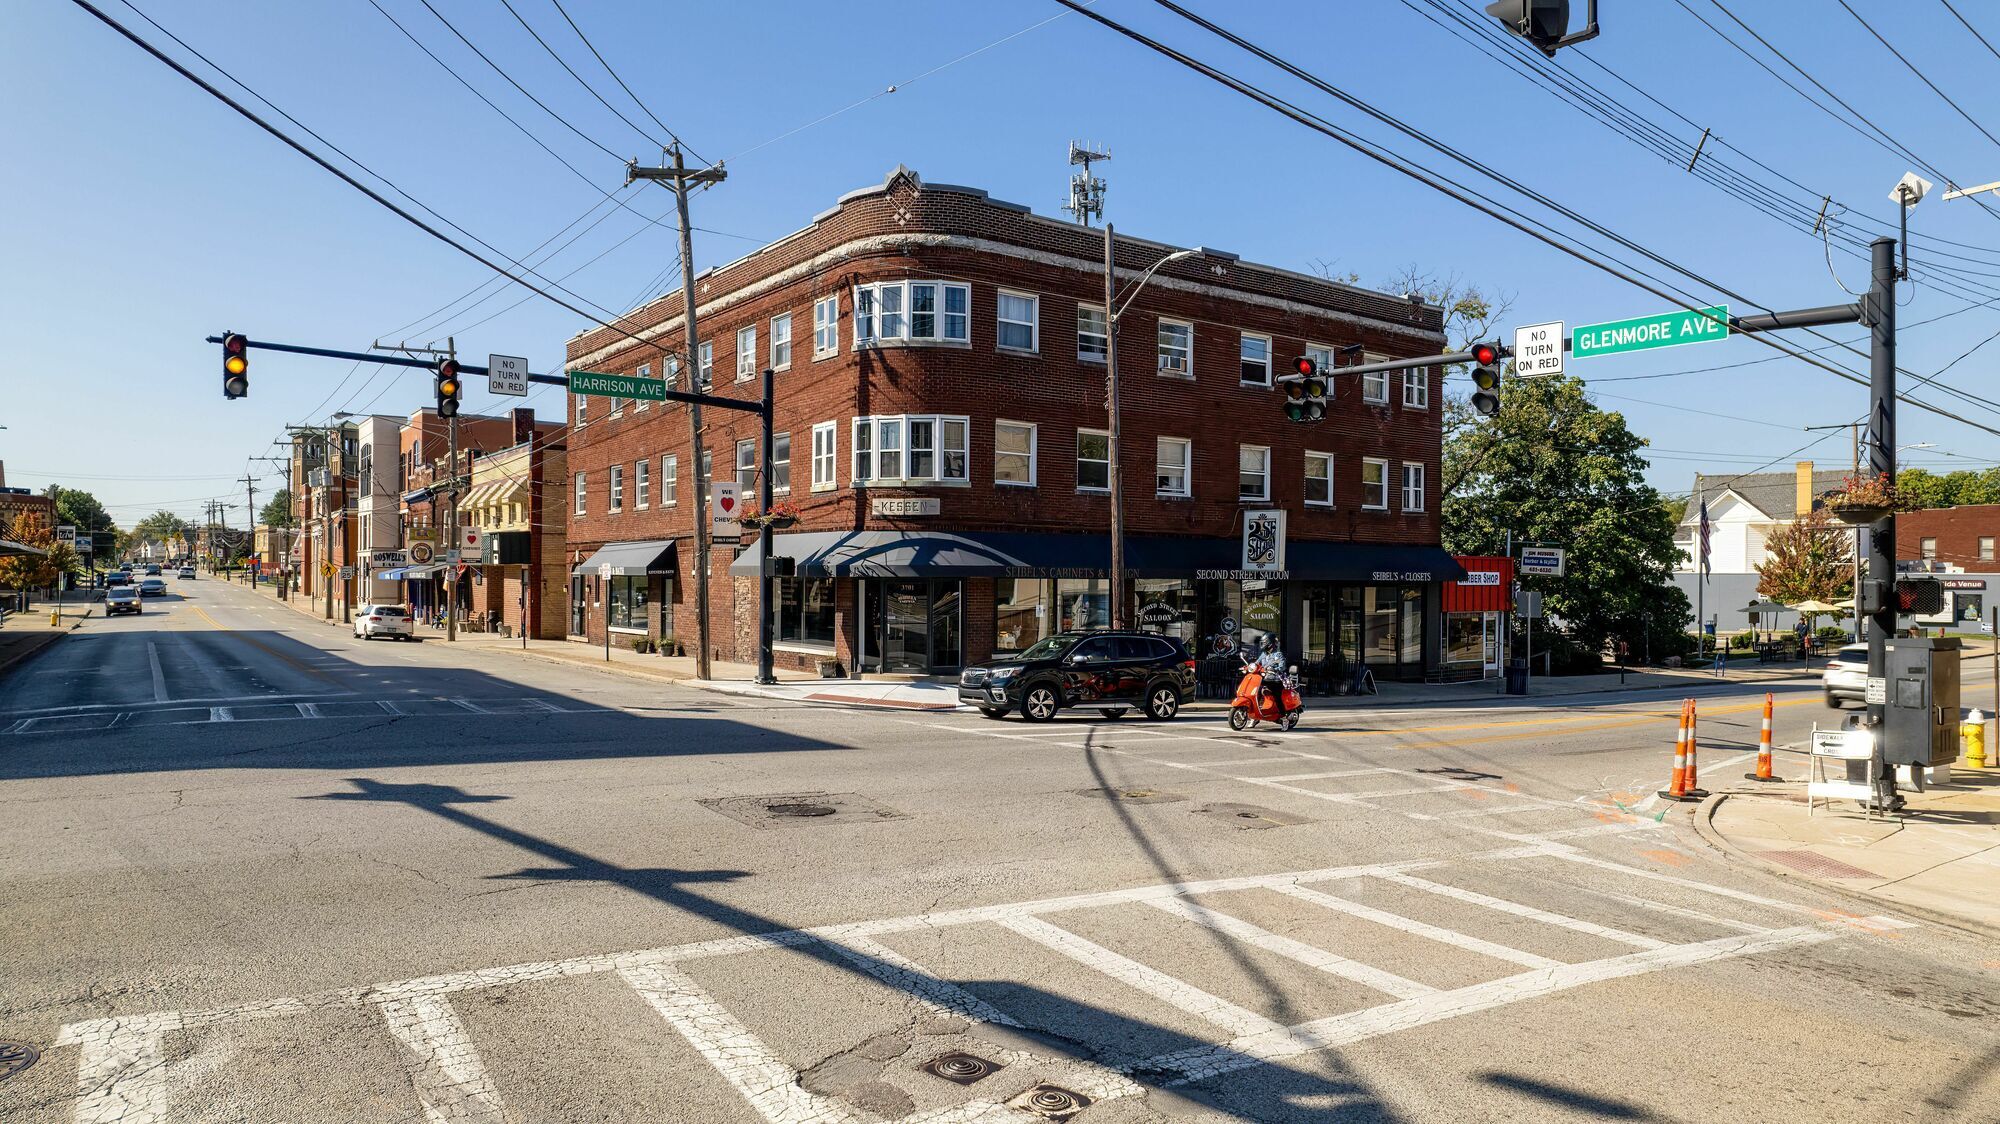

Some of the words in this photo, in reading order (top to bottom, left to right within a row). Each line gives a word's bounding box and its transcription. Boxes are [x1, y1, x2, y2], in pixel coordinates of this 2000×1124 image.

[1531, 330, 1547, 341] NO
[1580, 321, 1671, 350] GLENMORE
[1680, 315, 1719, 337] AVE
[1525, 344, 1553, 357] TURN
[502, 360, 515, 370] NO
[1518, 361, 1533, 372] ON
[1538, 357, 1559, 369] RED
[497, 370, 520, 380] TURN
[492, 381, 504, 390] ON
[508, 382, 524, 392] RED
[573, 376, 635, 394] HARRISON
[639, 383, 663, 397] AVE
[881, 501, 928, 513] KESSEN
[373, 552, 406, 562] ROSWELL'S
[1005, 567, 1047, 578] SEIBEL'S
[1049, 568, 1095, 579] CABINETS
[1097, 569, 1105, 579] &
[1196, 569, 1229, 579] SECOND
[1230, 570, 1257, 579] STREET
[1260, 570, 1290, 580] SALOON
[1372, 571, 1399, 581] SEIBEL'S
[1405, 572, 1432, 581] CLOSETS
[1482, 572, 1499, 584] SHOP
[1138, 602, 1158, 617] SECOND
[1159, 602, 1180, 617] STREET
[1144, 614, 1172, 622] SALOON
